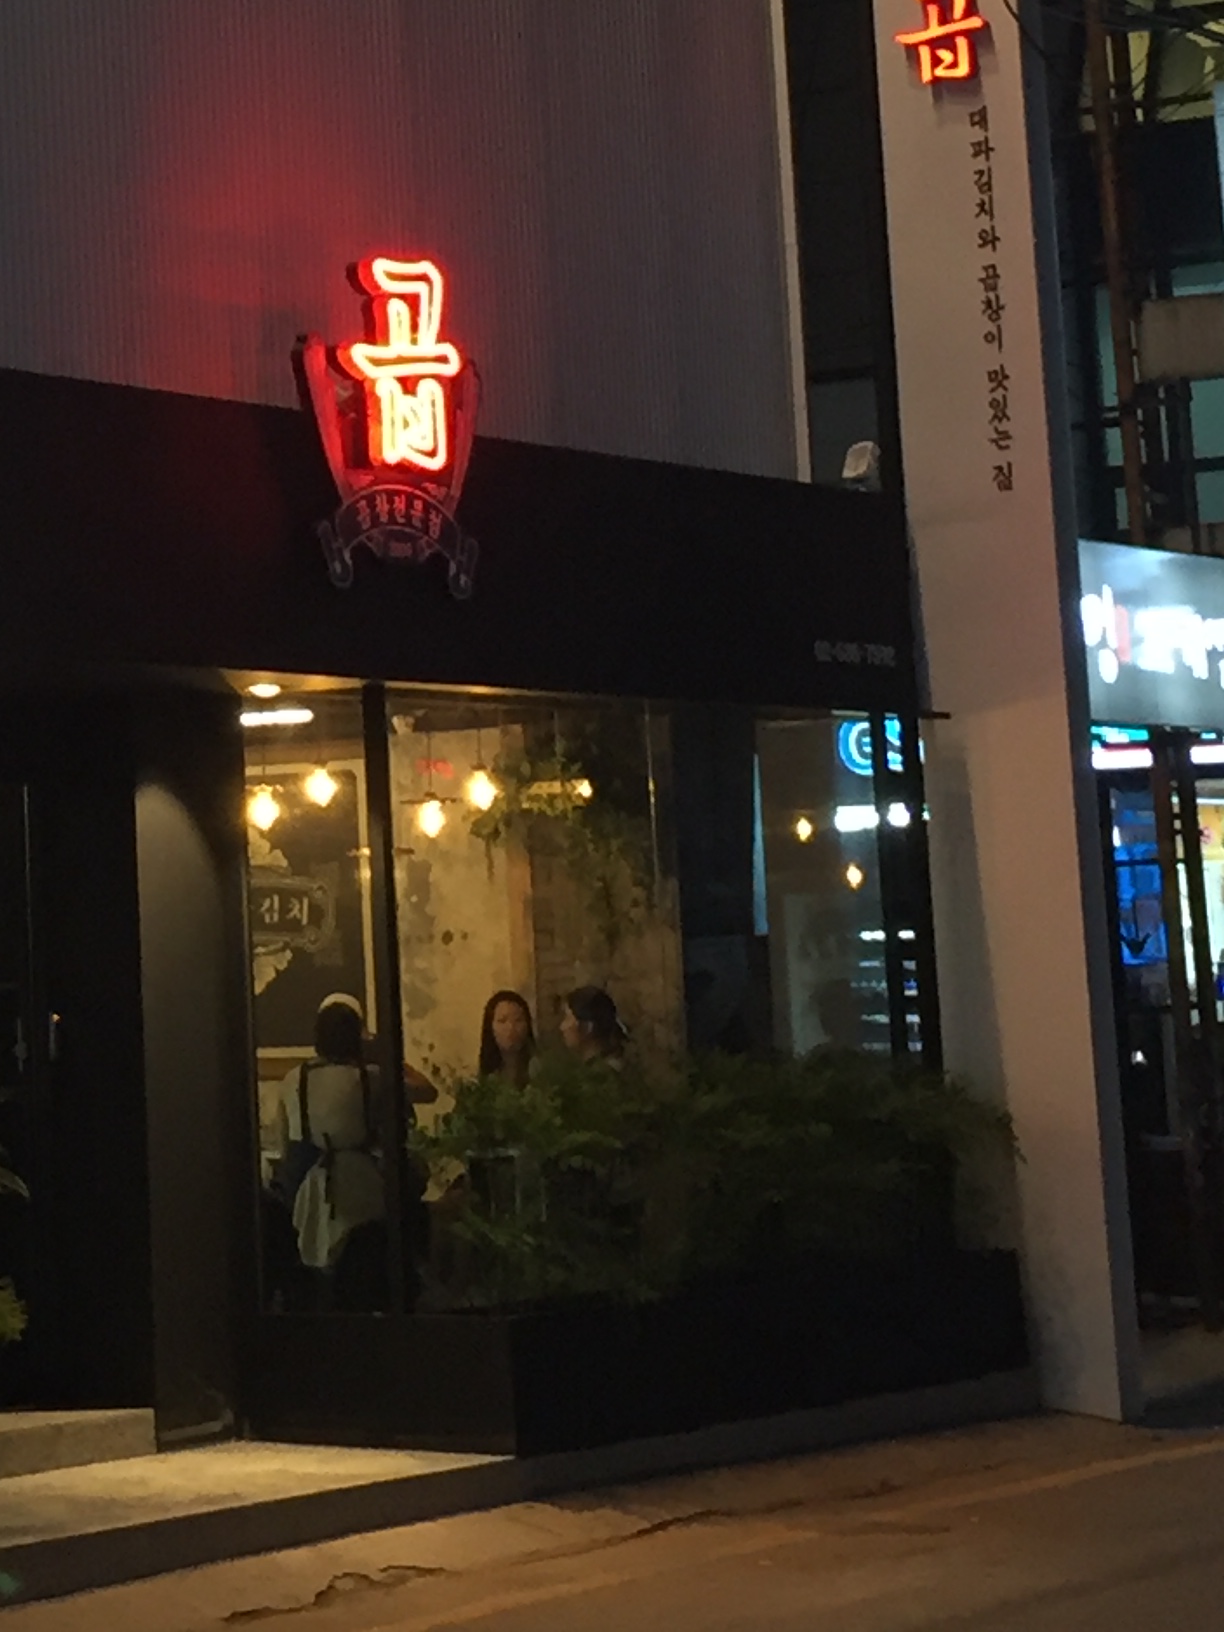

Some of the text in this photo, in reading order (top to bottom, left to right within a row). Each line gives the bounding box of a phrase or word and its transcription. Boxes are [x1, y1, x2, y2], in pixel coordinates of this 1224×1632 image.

[351, 257, 461, 471] 곱
[968, 105, 1014, 492] 대파김치와 곱창이 맛있는 집
